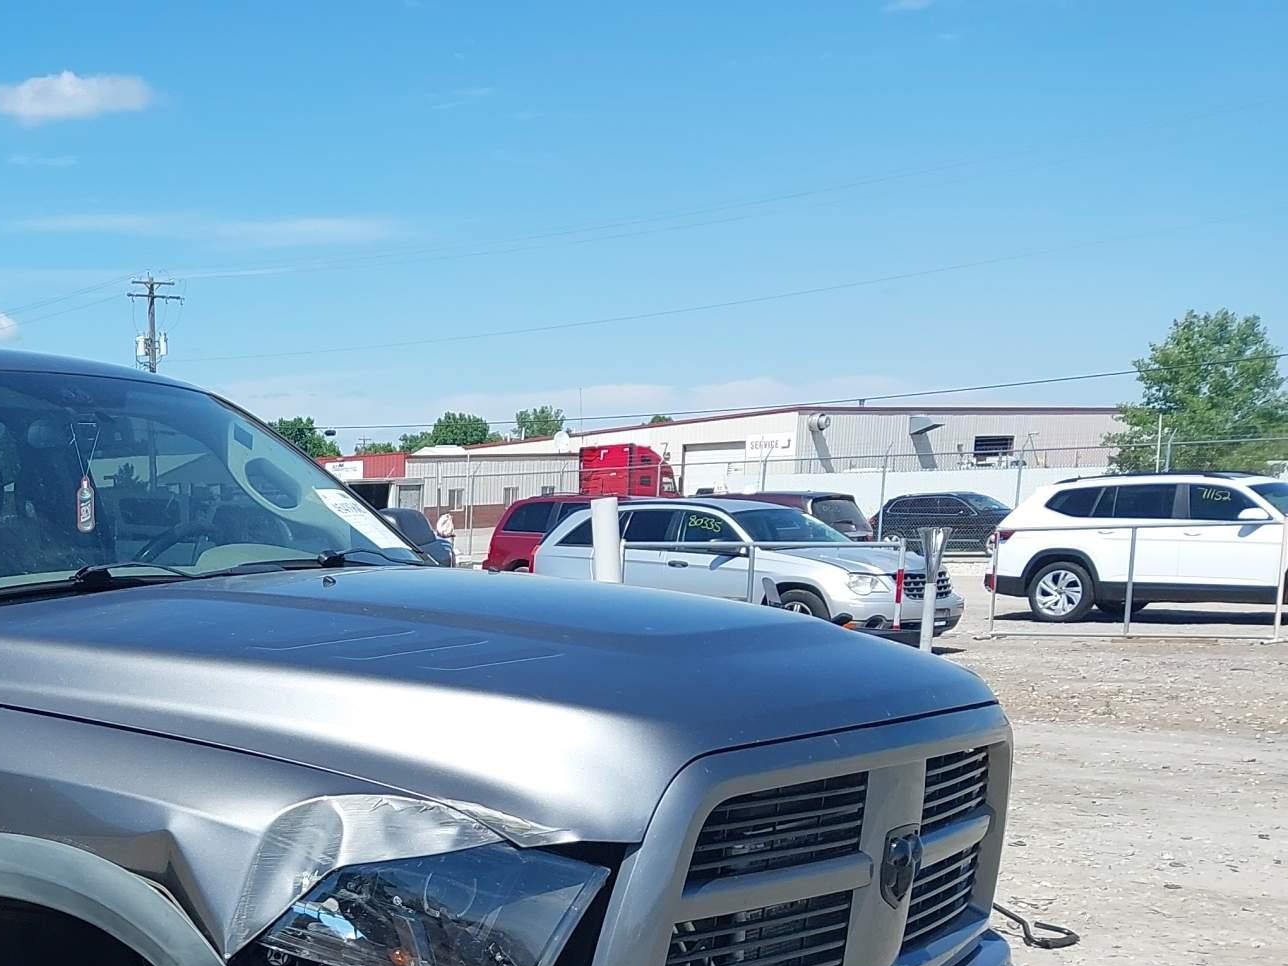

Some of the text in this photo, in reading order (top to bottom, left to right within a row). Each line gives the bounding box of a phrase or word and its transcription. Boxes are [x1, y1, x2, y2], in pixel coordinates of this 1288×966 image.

[750, 439, 779, 450] SERVICE
[1197, 487, 1232, 501] 71152
[688, 514, 722, 532] 80335
